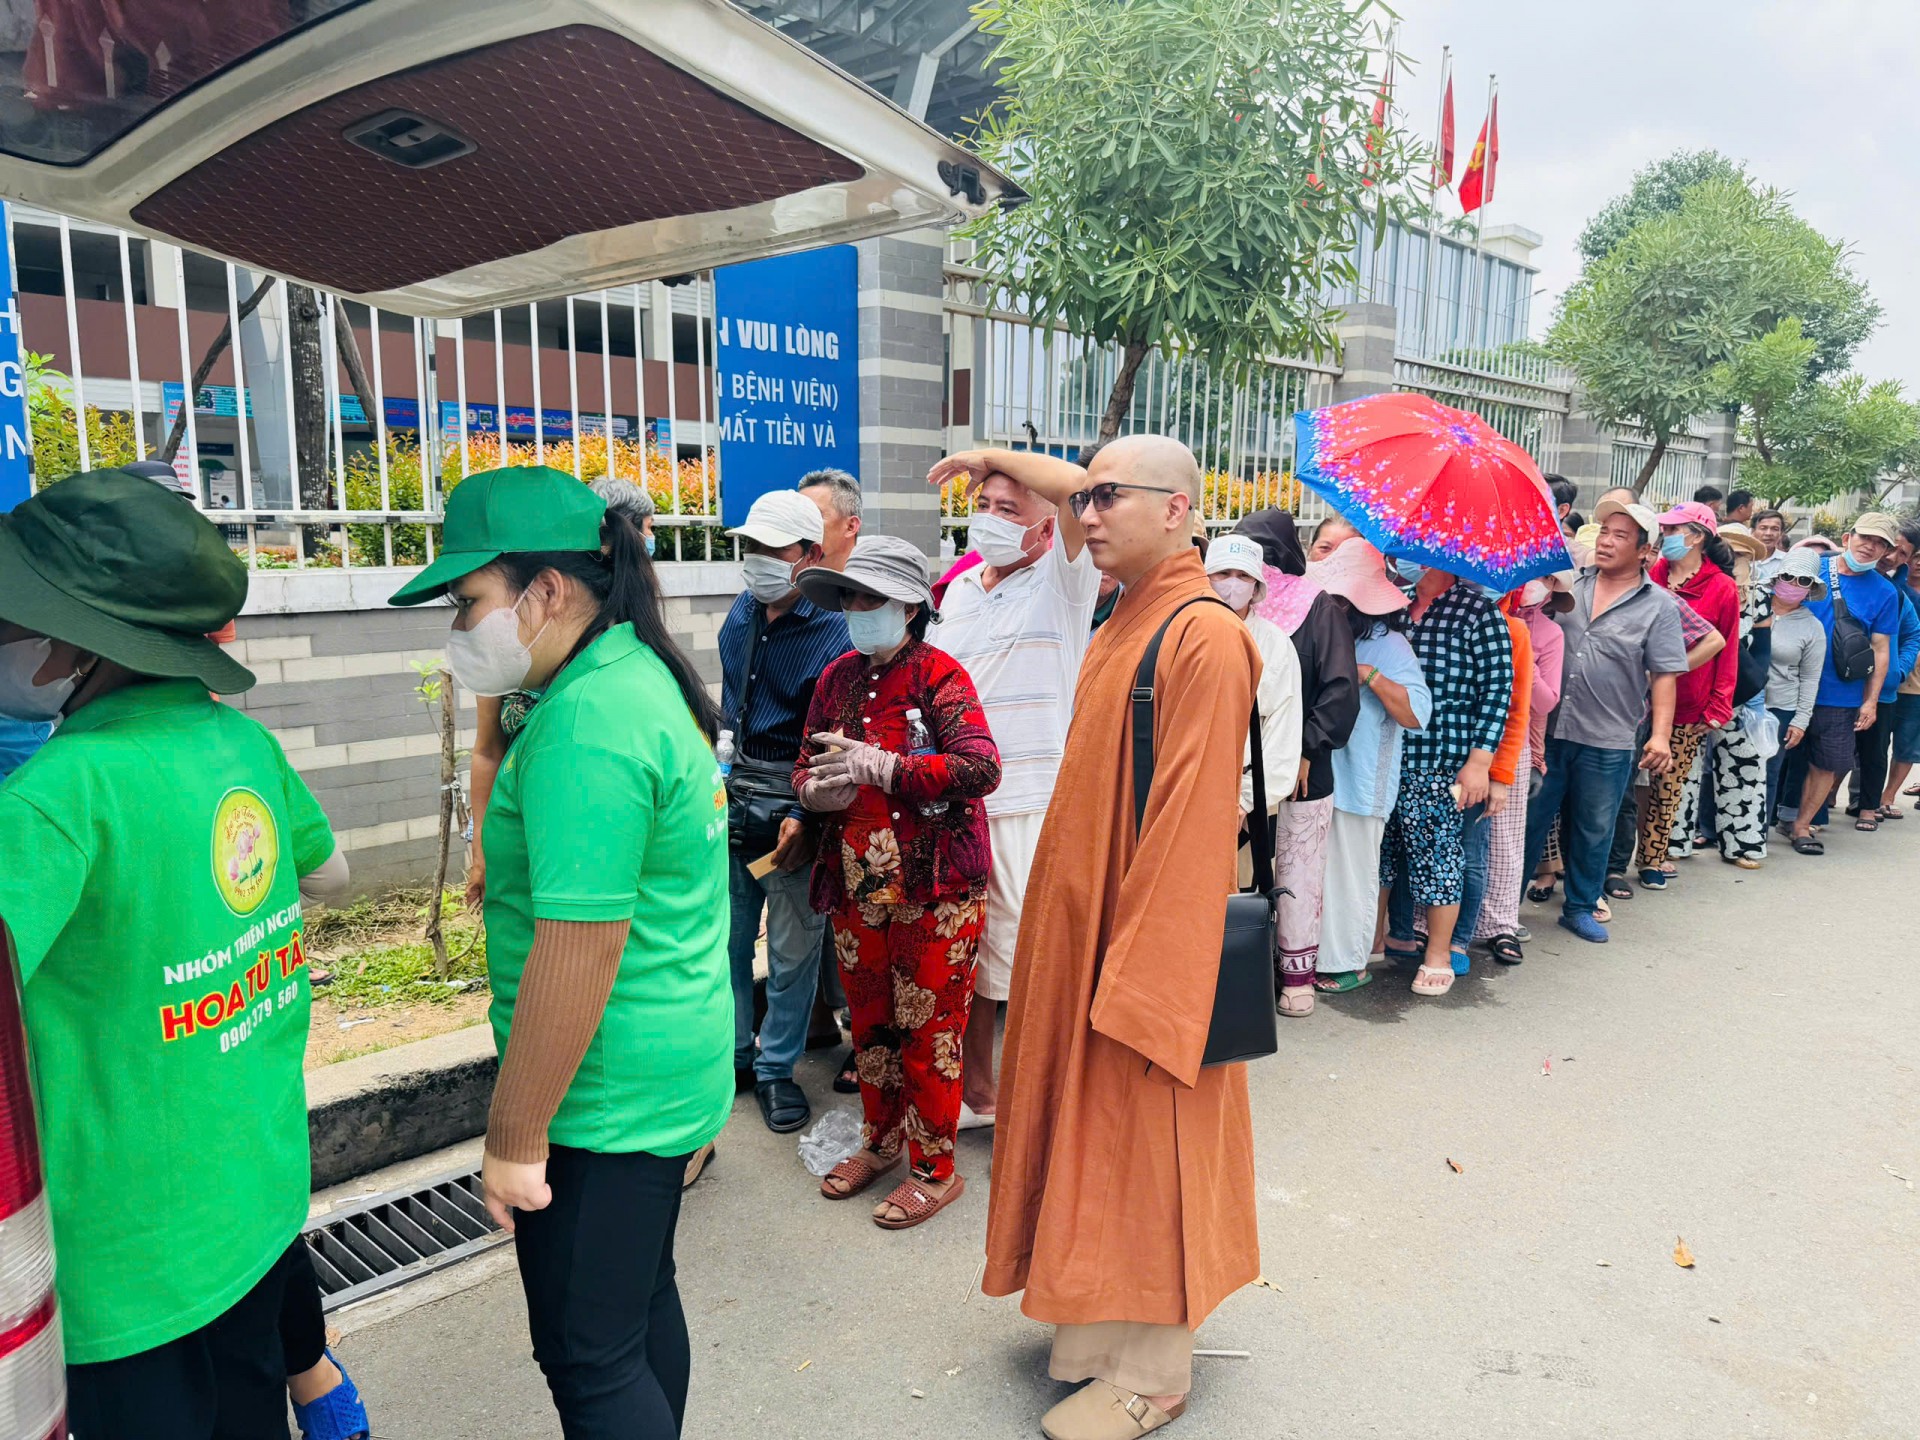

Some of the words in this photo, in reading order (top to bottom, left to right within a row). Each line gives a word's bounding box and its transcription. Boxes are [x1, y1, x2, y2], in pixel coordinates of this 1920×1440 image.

[736, 318, 778, 352] VUI
[785, 322, 839, 360] LÒNG
[732, 370, 784, 405] BỆNH
[791, 377, 839, 411] VIỆN)
[719, 409, 758, 443] MẤT
[764, 412, 805, 446] TIỀN
[812, 419, 836, 448] VÀ
[162, 945, 232, 985] NHÓM
[234, 922, 265, 958] THIỆN
[159, 979, 246, 1042] HOA
[245, 950, 271, 1000] TỪ
[274, 929, 307, 979] TÂ
[219, 1013, 252, 1053] 0902
[251, 997, 272, 1028] 379
[277, 980, 298, 1009] 560
